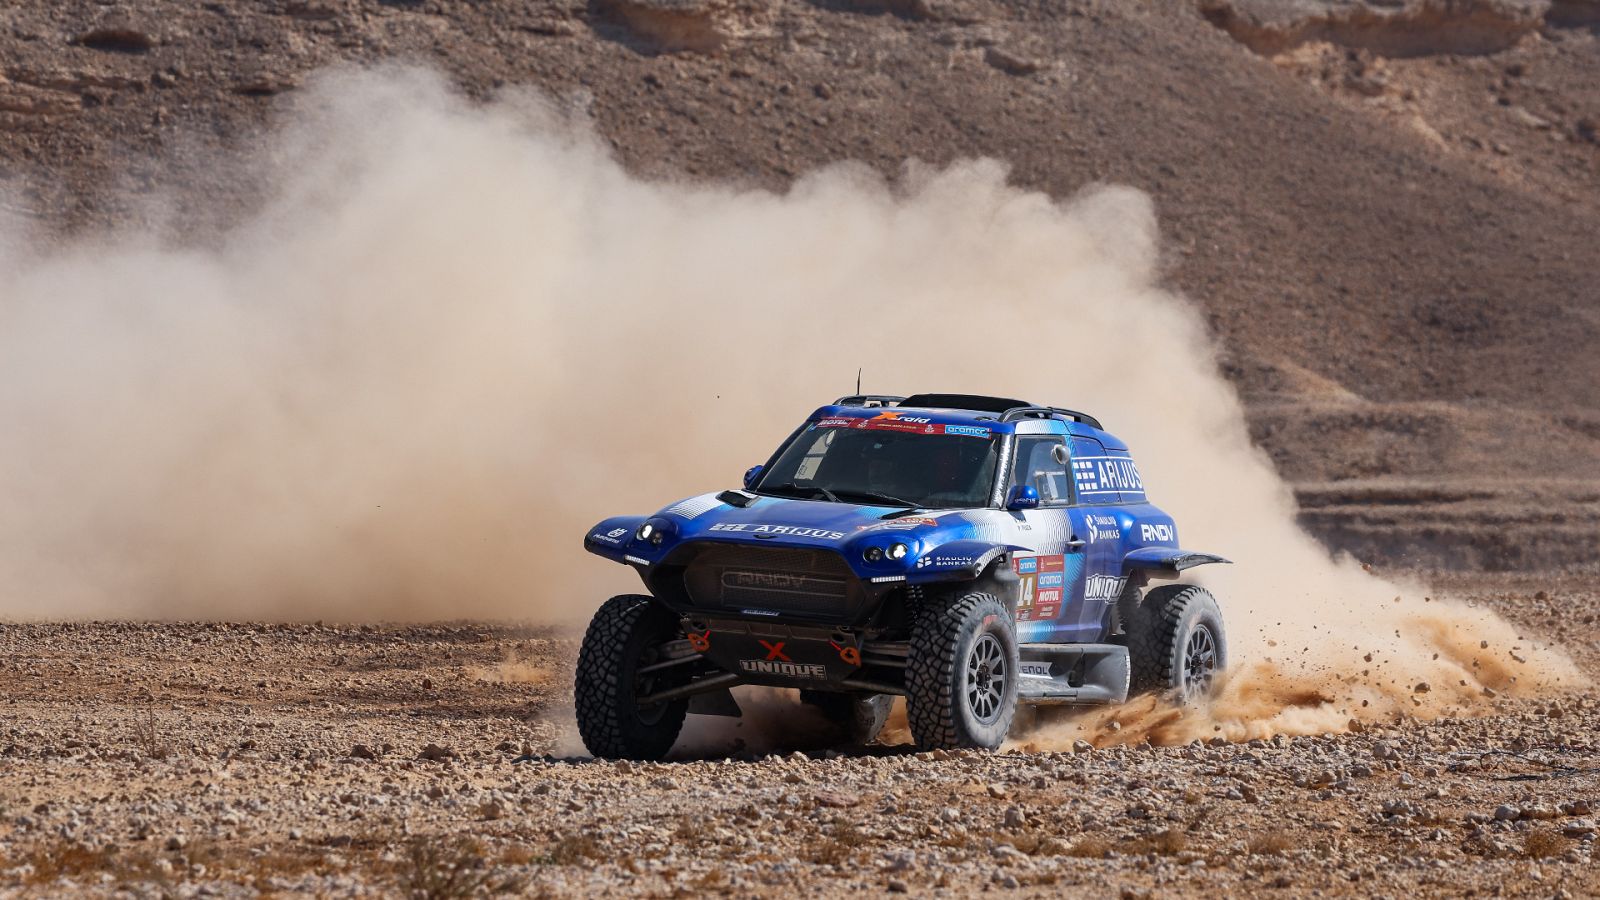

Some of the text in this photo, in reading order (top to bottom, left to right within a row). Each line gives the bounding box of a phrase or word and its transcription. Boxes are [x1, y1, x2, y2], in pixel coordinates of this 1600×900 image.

[1097, 461, 1143, 489] ARIJUS
[755, 525, 846, 540] ARIJUS
[1099, 529, 1120, 540] BANKAS
[1141, 524, 1174, 541] RNDV
[1039, 575, 1061, 585] aramco
[1038, 590, 1059, 602] MOTUL
[741, 660, 825, 676] UNIQUE
[1019, 665, 1048, 675] ENOL
